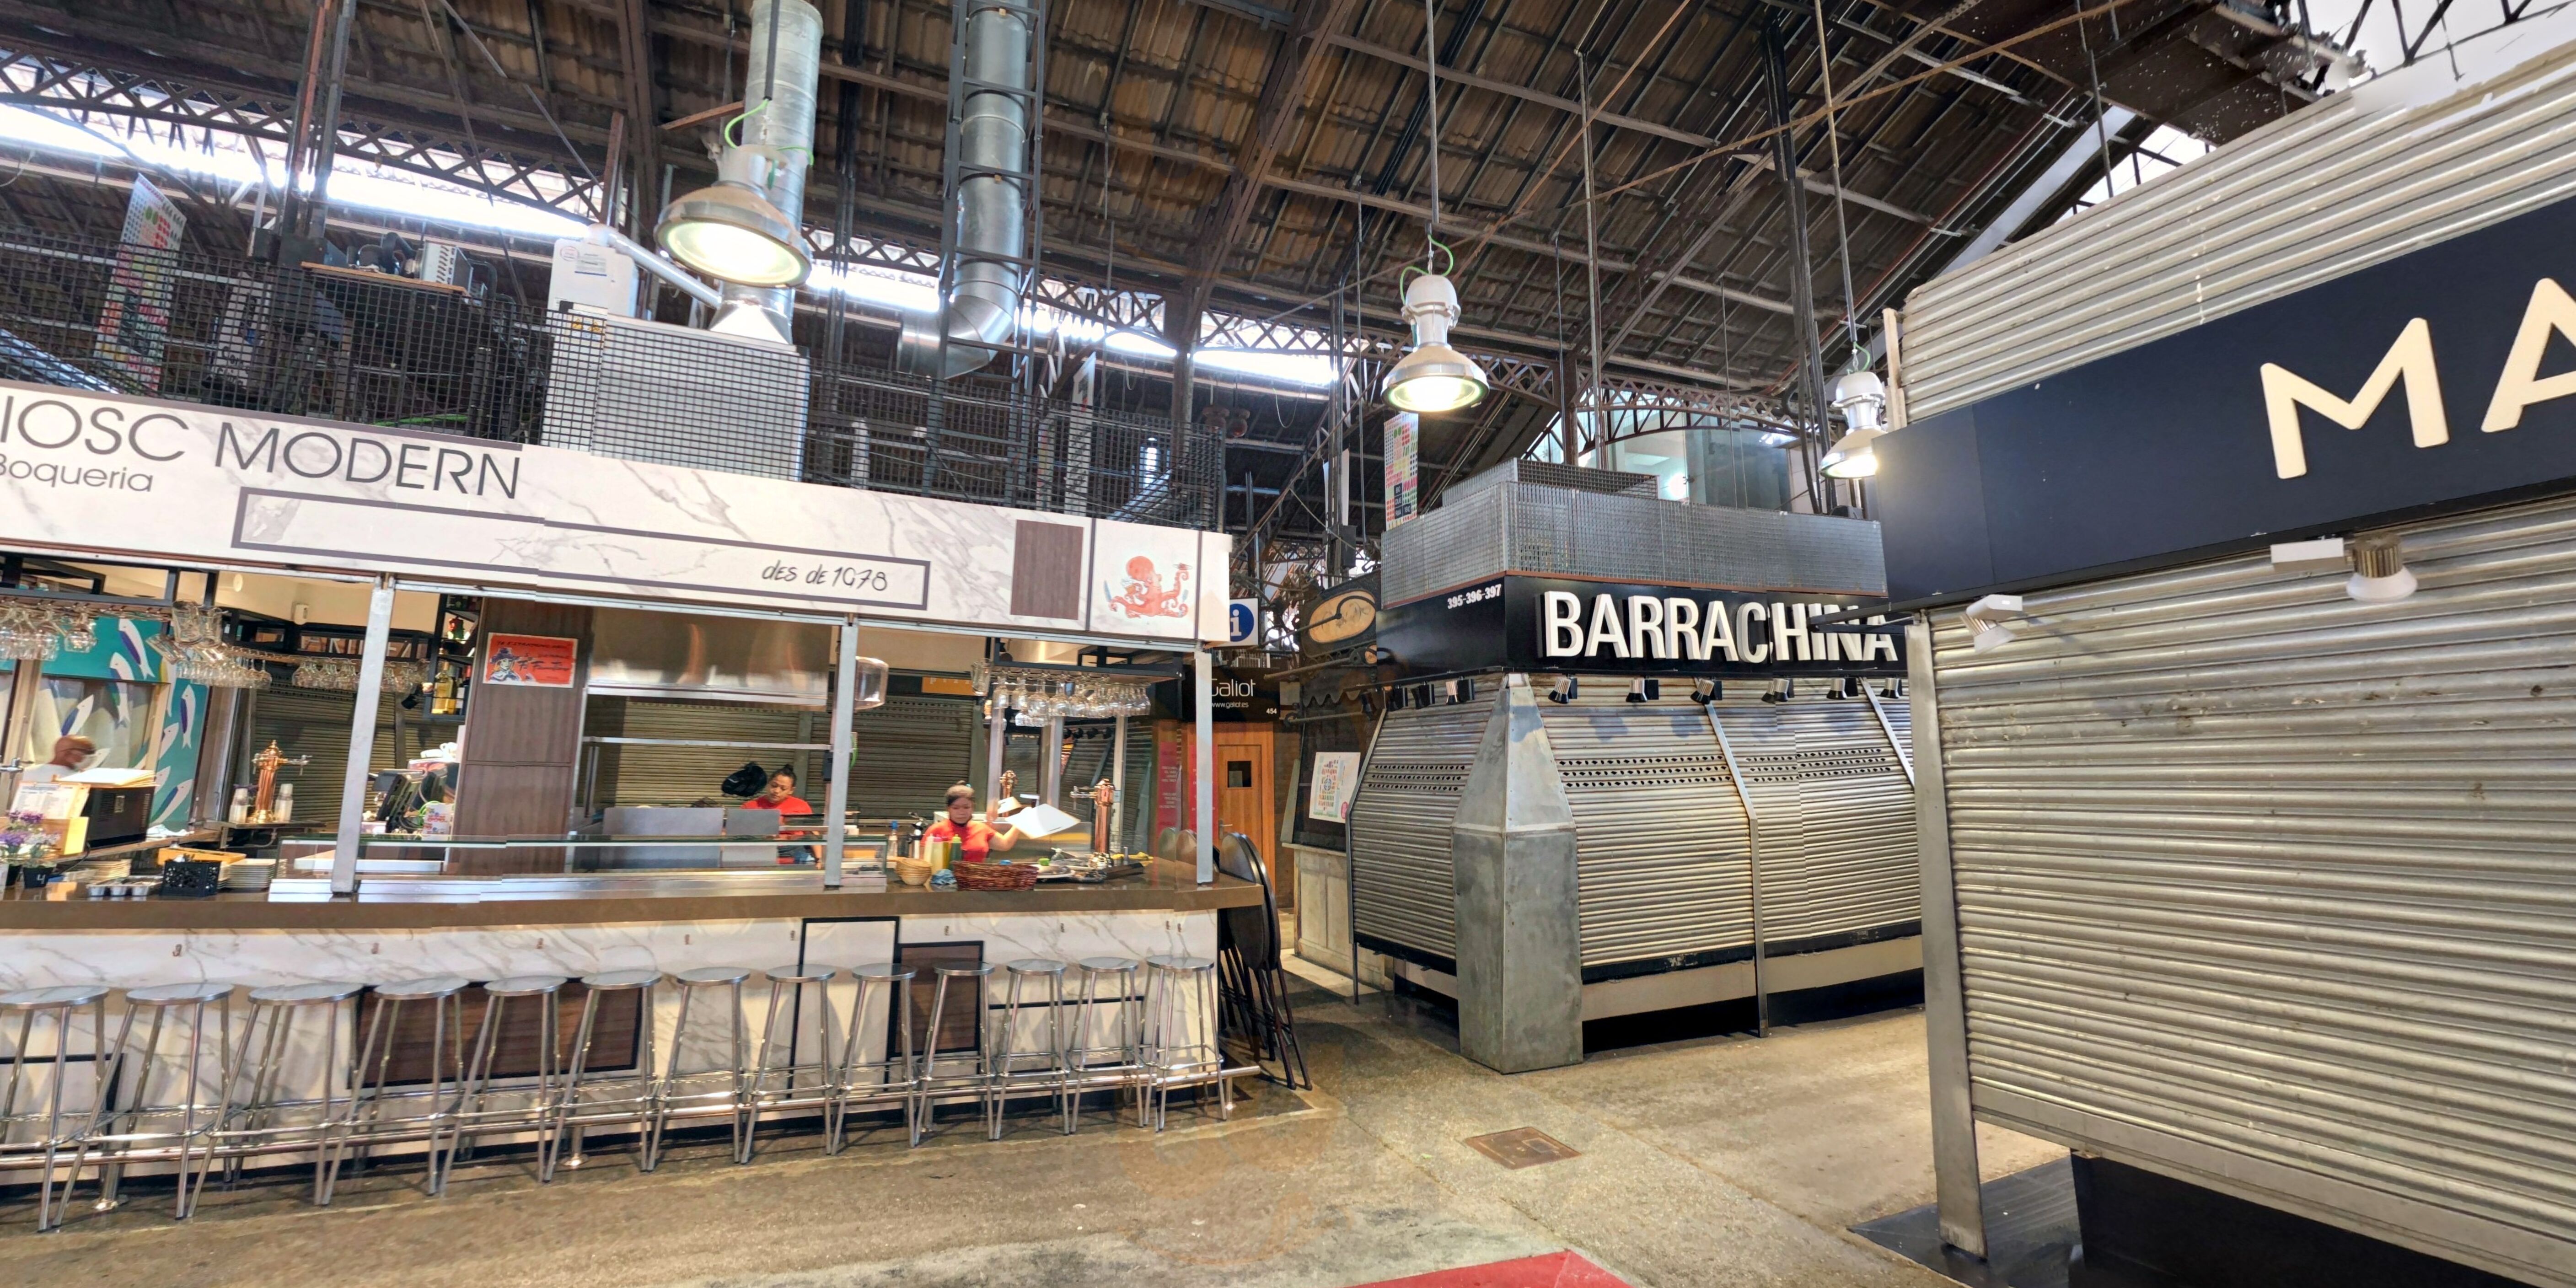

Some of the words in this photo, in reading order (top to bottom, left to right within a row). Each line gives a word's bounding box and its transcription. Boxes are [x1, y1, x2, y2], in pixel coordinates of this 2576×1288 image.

[215, 422, 520, 499] MODERN
[1447, 584, 1502, 609] 395-396-397
[1544, 590, 1899, 664] BARRACHINA
